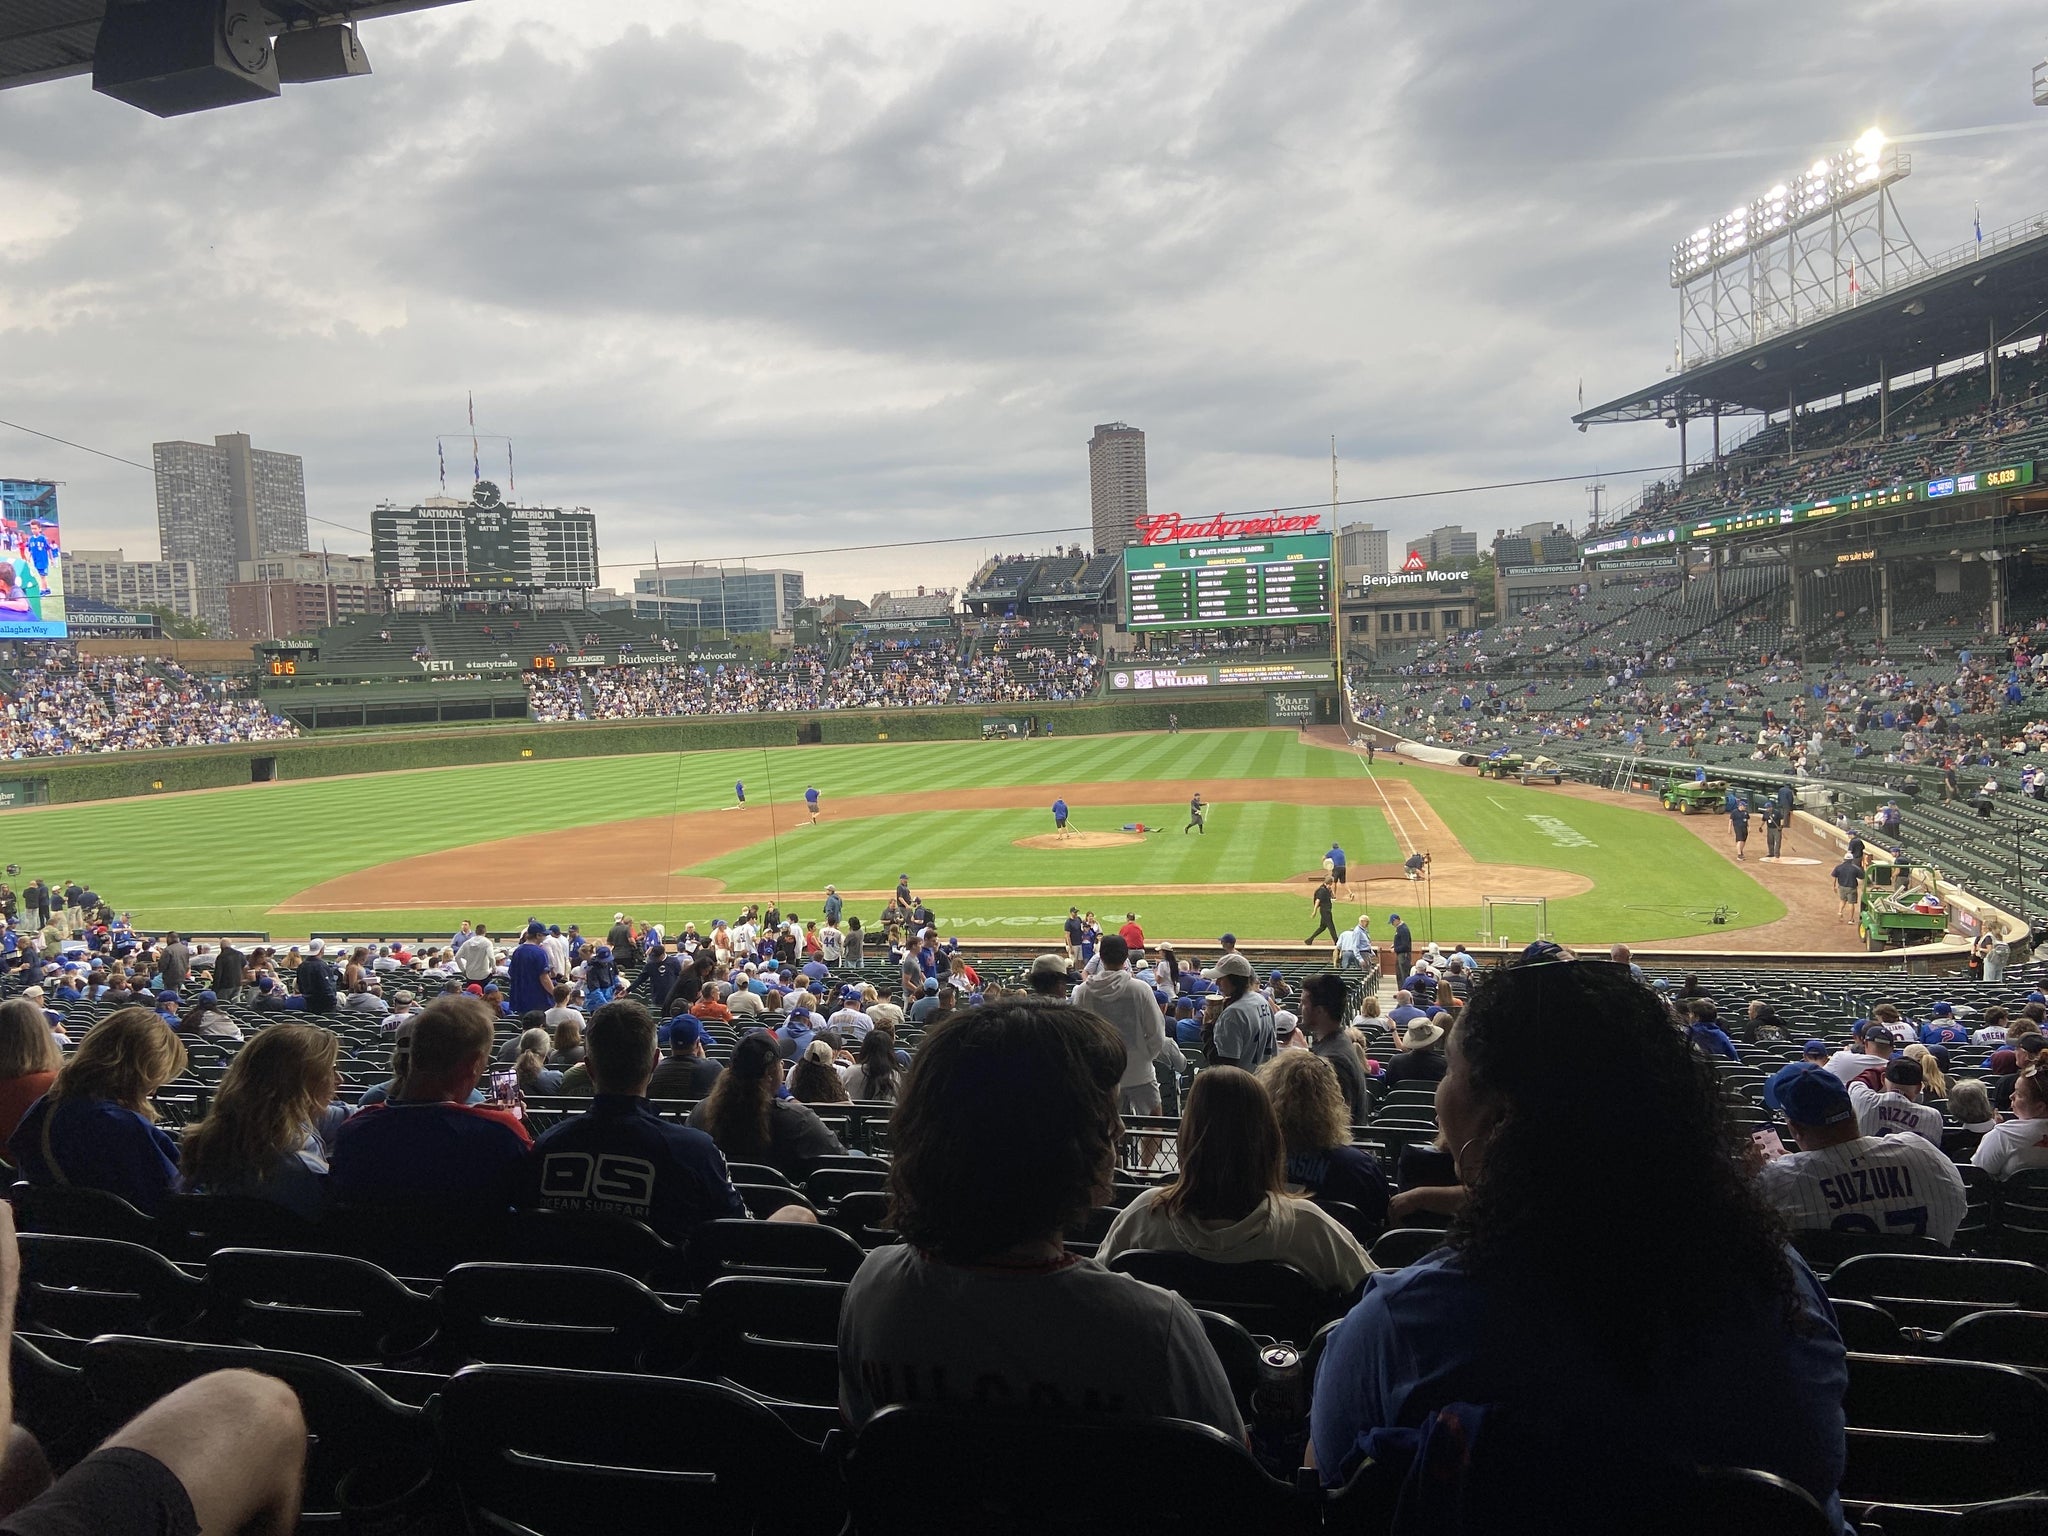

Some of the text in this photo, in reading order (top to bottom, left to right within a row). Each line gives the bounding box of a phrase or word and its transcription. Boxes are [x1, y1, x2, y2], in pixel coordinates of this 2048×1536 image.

[1987, 469, 2016, 487] $6,039
[1957, 481, 1977, 492] TOTAL
[418, 509, 465, 518] NATIONAL
[511, 511, 555, 520] AMERICAN
[1135, 509, 1320, 545] Budweiser
[1510, 565, 1578, 574] WRIGLEYROOFTOPS.COM
[1600, 560, 1673, 569] WRIGLEYROOFTOPS.COM
[1363, 570, 1469, 587] Benjamin Moore
[33, 626, 48, 635] Way
[288, 640, 313, 648] Mobile
[566, 655, 606, 663] GRAINGER
[618, 655, 678, 665] Budweiser
[700, 652, 737, 661] Advocate
[274, 661, 295, 675] 0:15
[420, 660, 454, 672] YETI
[473, 660, 518, 670] tastytrade
[1155, 675, 1208, 687] WILLIAMS
[1275, 697, 1310, 706] DRAFT
[823, 937, 835, 947] 44
[1878, 1106, 1920, 1129] RIZZO
[1819, 1166, 1913, 1210] SUZUKI
